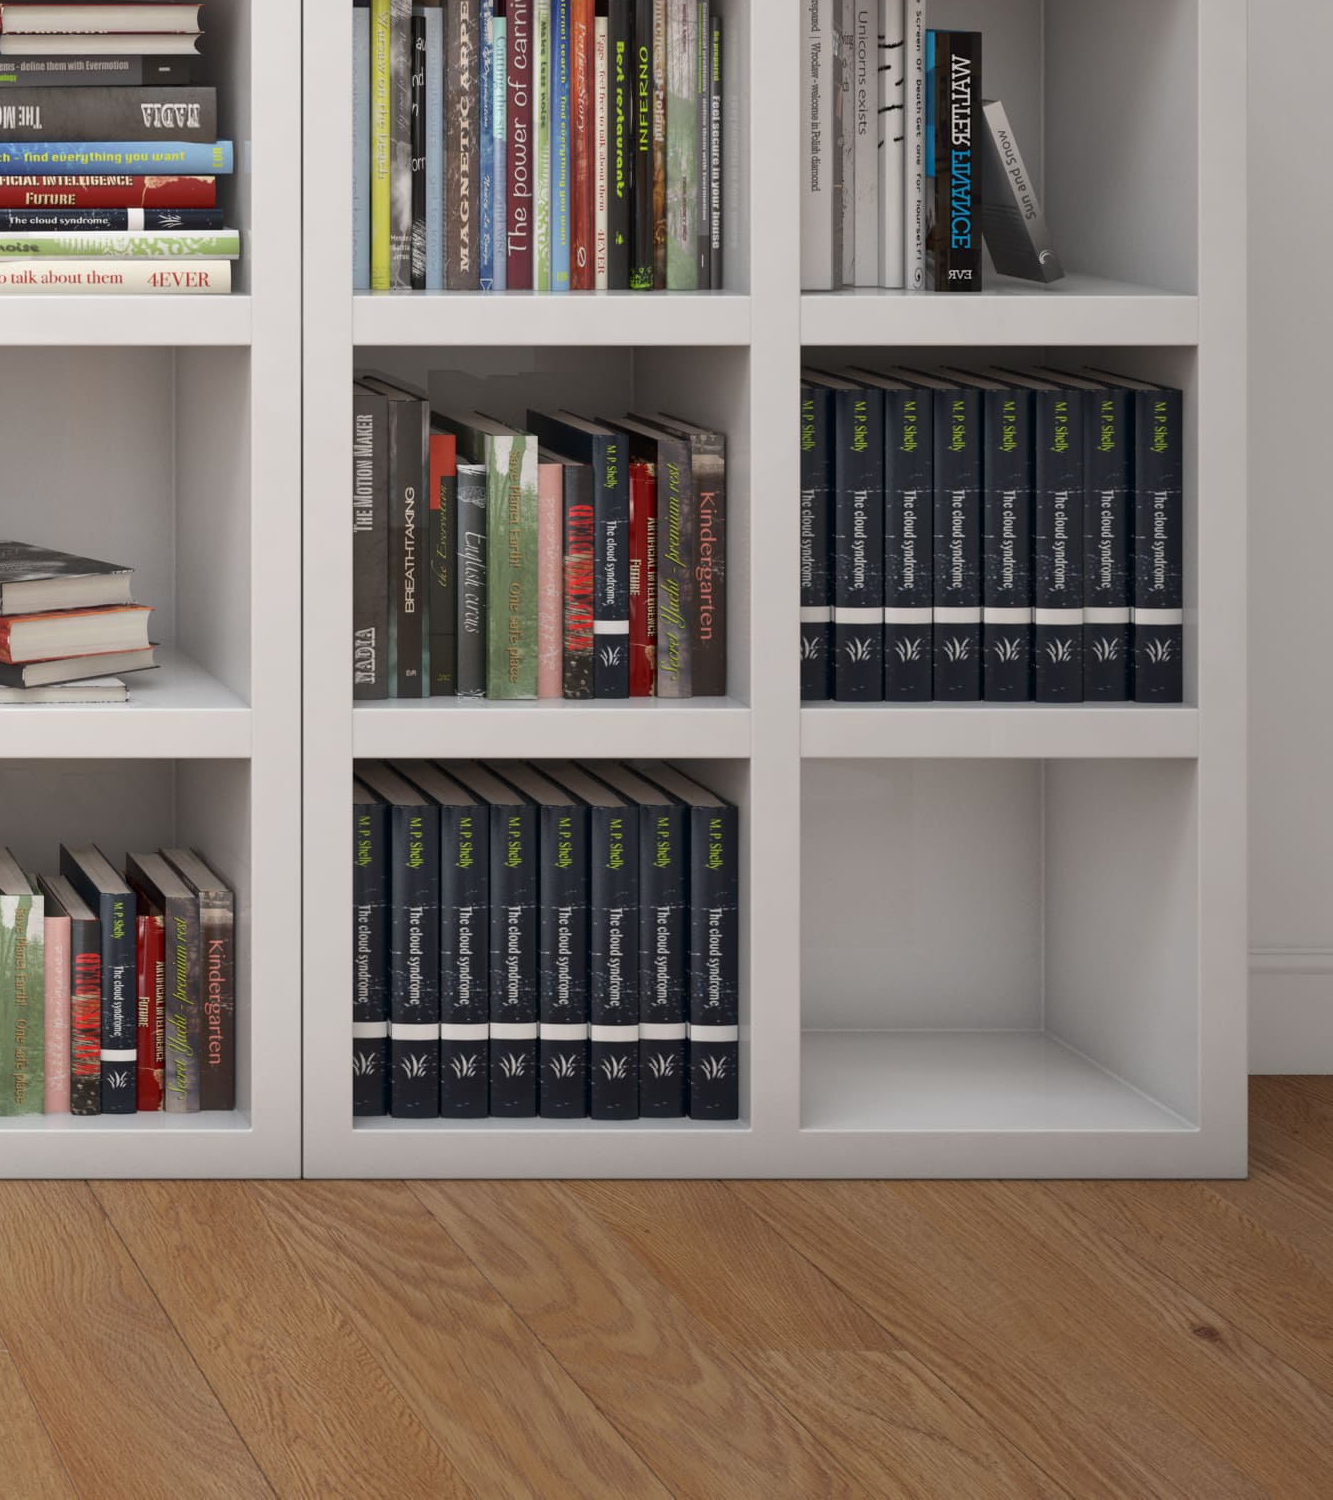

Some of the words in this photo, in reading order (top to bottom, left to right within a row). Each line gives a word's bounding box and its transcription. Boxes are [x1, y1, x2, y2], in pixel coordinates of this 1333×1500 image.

[617, 41, 625, 81] Best
[858, 10, 869, 85] Unicorns
[21, 62, 44, 70] define
[47, 62, 66, 70] them
[68, 62, 84, 70] with
[86, 61, 128, 70] Evermotion
[507, 76, 526, 107] of
[638, 46, 648, 151] INFERNO
[141, 104, 200, 127] NADIA
[859, 89, 868, 134] exists
[24, 152, 48, 162] find
[52, 152, 122, 164] everything
[125, 153, 149, 164] you
[152, 151, 184, 162] want
[513, 117, 531, 196] power
[616, 88, 625, 196] restaurants
[26, 192, 75, 204] FUTURE
[459, 96, 470, 271] MAGNETIC
[9, 215, 27, 223] The
[507, 207, 526, 256] The
[853, 426, 868, 452] Shelly
[854, 490, 867, 508] The
[854, 511, 867, 538] cloud
[405, 487, 414, 612] BREATHTAKING
[695, 492, 717, 640] Kindergarten
[508, 906, 521, 923] The
[509, 927, 521, 953] cloud
[204, 939, 224, 1065] Kindergarten
